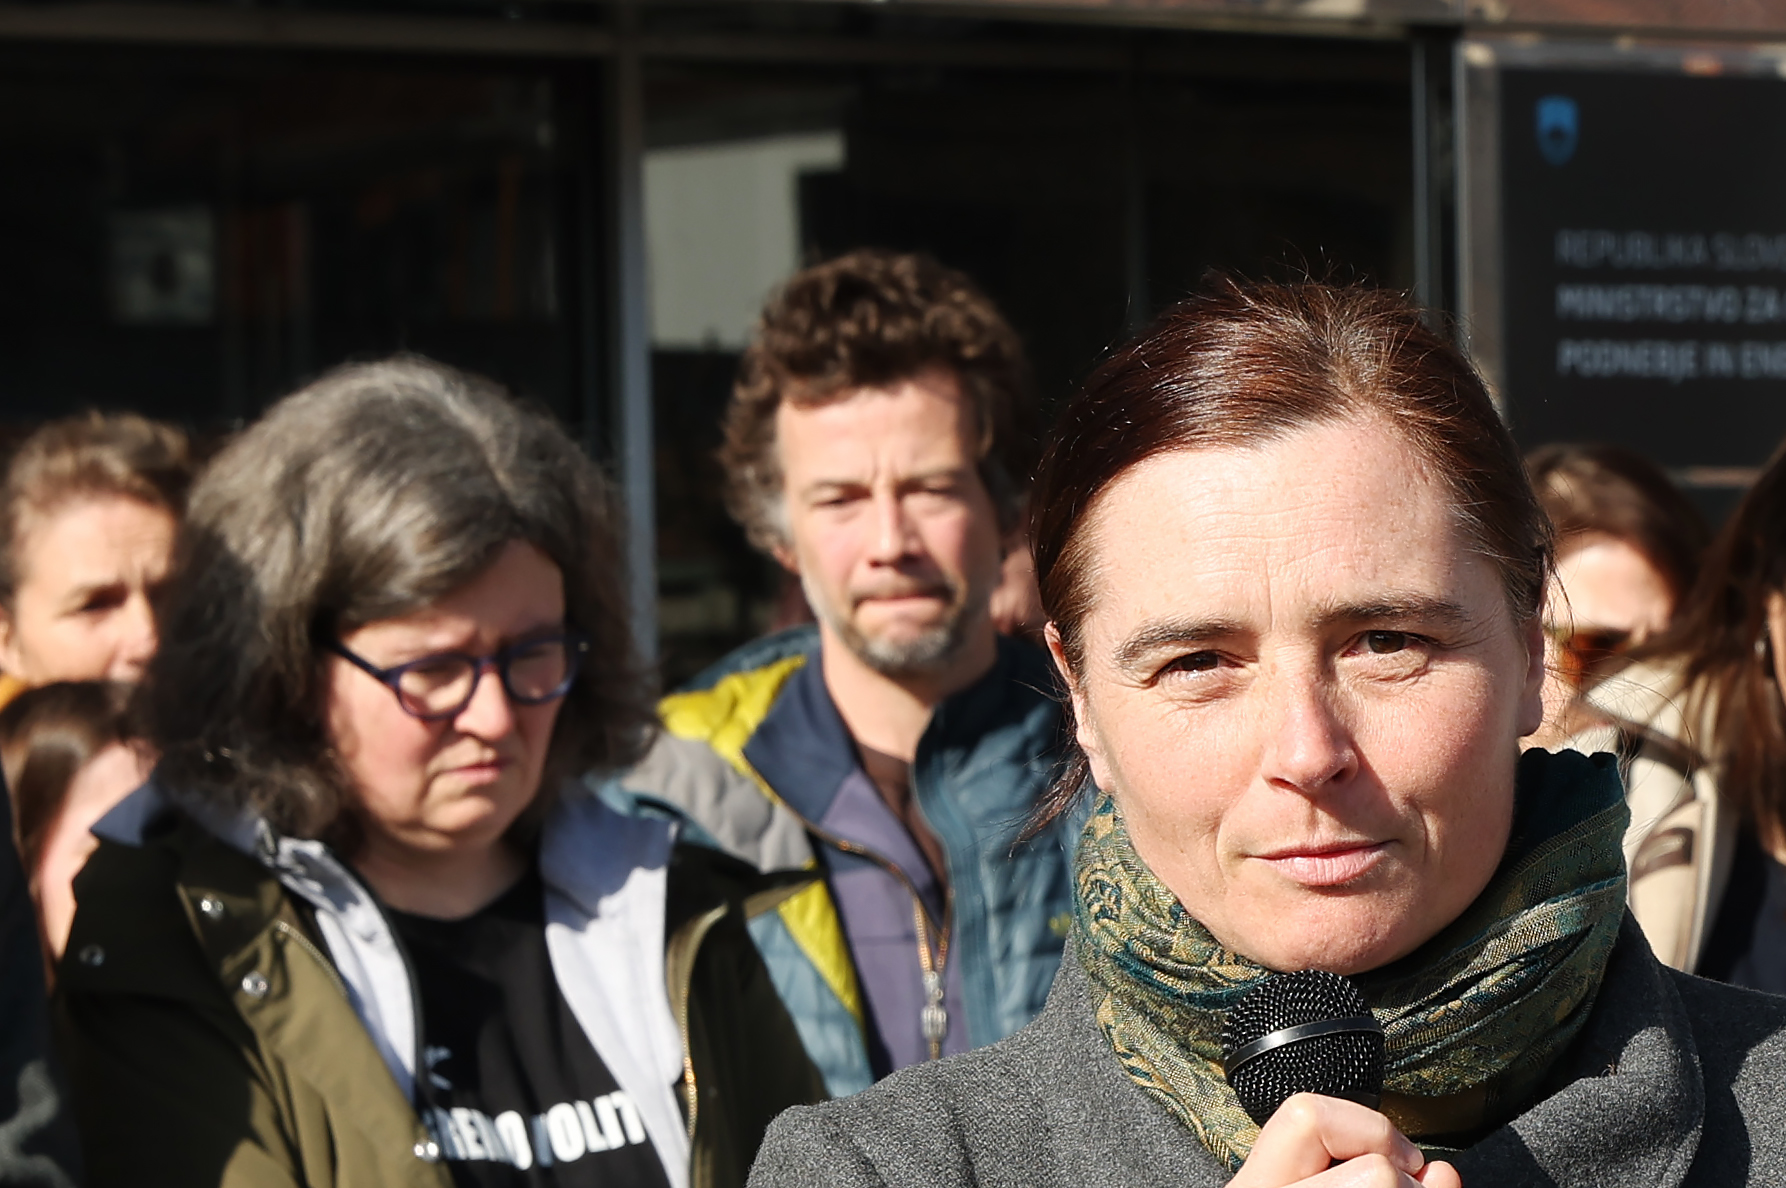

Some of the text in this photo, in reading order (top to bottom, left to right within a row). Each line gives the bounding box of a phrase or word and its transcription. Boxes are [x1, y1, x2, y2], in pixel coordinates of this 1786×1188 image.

[1555, 231, 1709, 268] REPUBLIKA
[1556, 284, 1741, 321] MINISTRSTVO
[1743, 287, 1782, 323] ZA
[1558, 340, 1702, 383] PODNEBJE
[1703, 342, 1735, 376] IN
